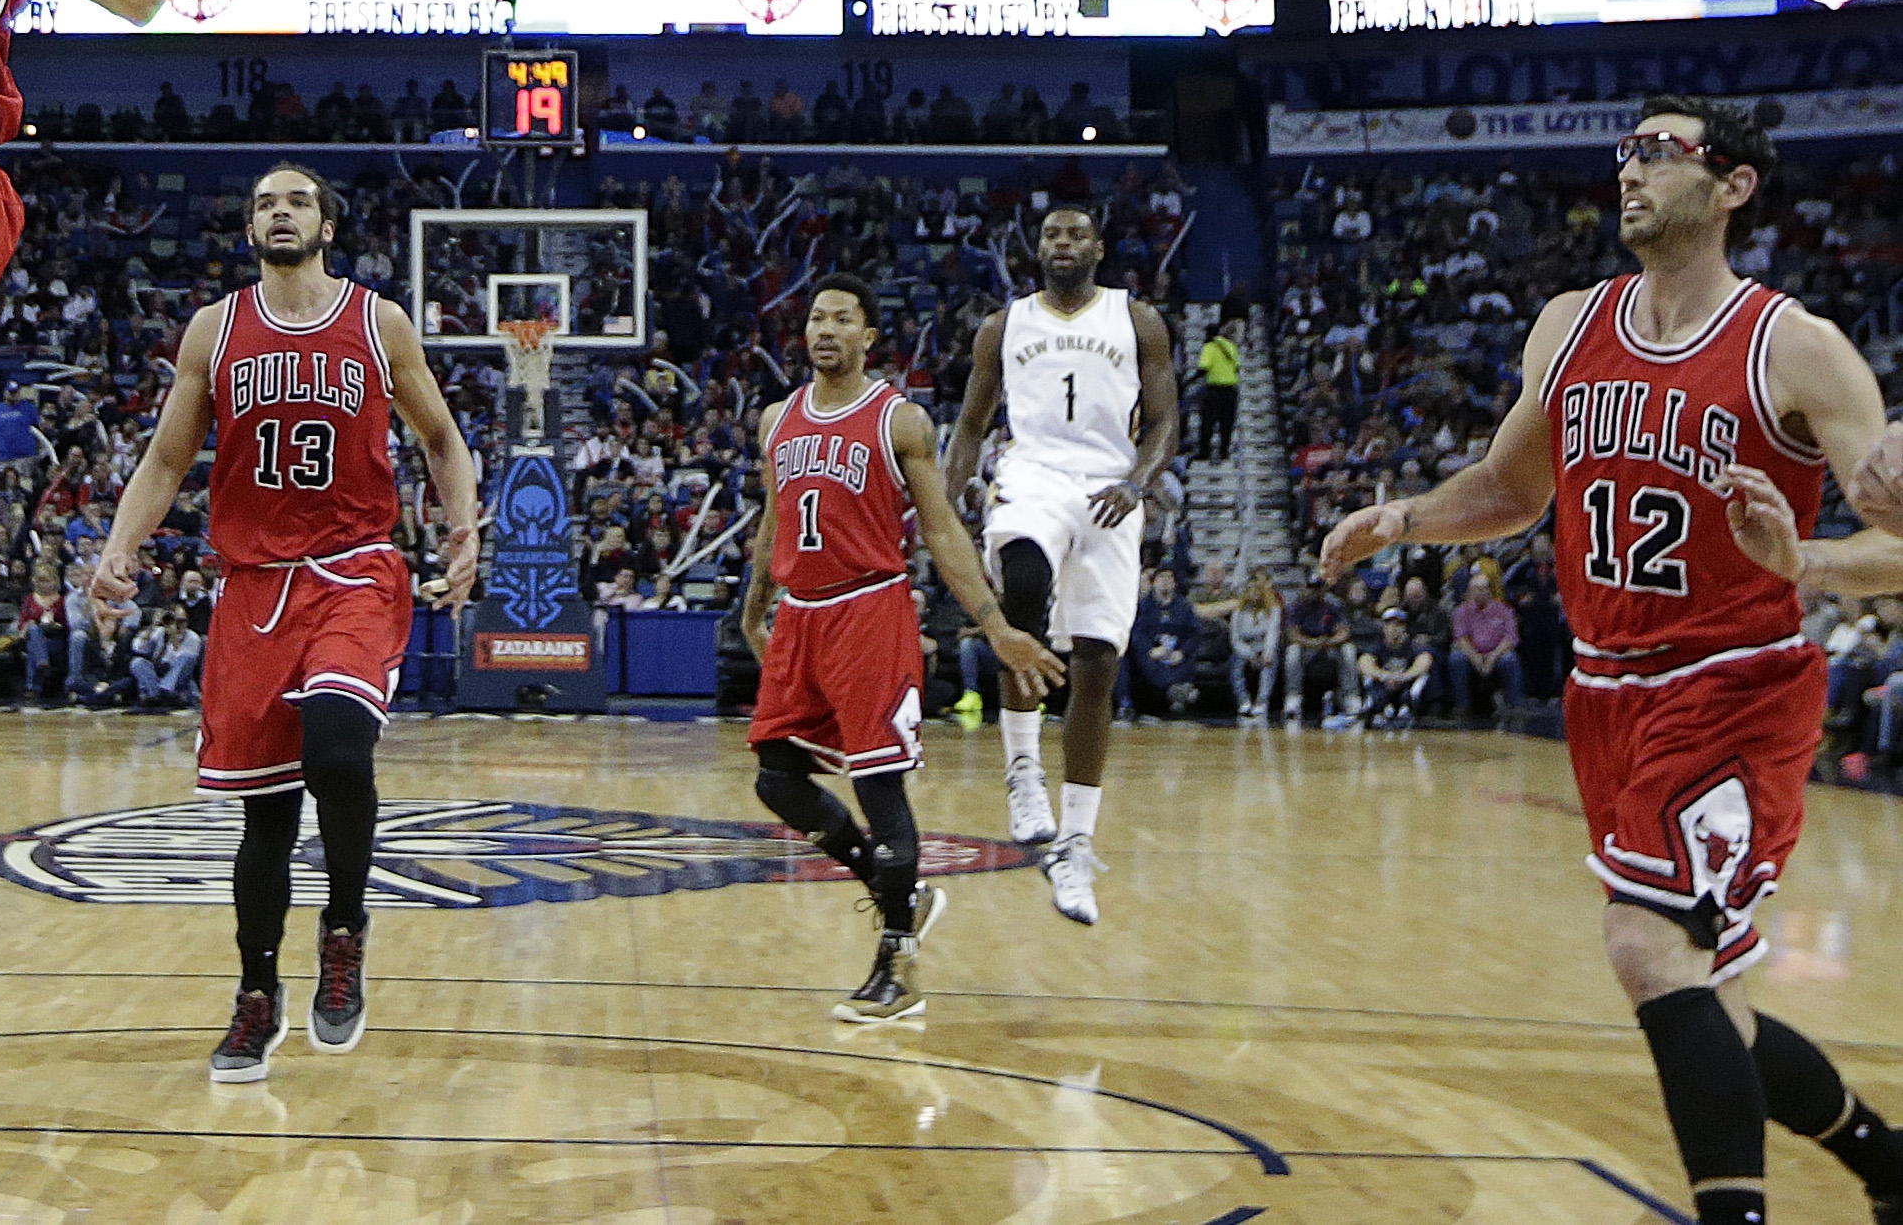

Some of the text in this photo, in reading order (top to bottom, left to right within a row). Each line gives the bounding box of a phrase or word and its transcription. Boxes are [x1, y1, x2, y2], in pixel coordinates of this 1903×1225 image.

[307, 0, 457, 33] PRESENTED
[218, 60, 268, 95] 118
[507, 60, 568, 88] 4:49
[516, 86, 562, 136] 19
[1015, 335, 1125, 369] NEW ORLEANS
[230, 350, 365, 419] BULLS
[1062, 371, 1077, 422] 1
[253, 417, 336, 491] 13
[774, 433, 871, 495] BULLS
[1561, 378, 1741, 499] BULLS
[797, 488, 824, 551] 1
[1582, 477, 1692, 598] 12
